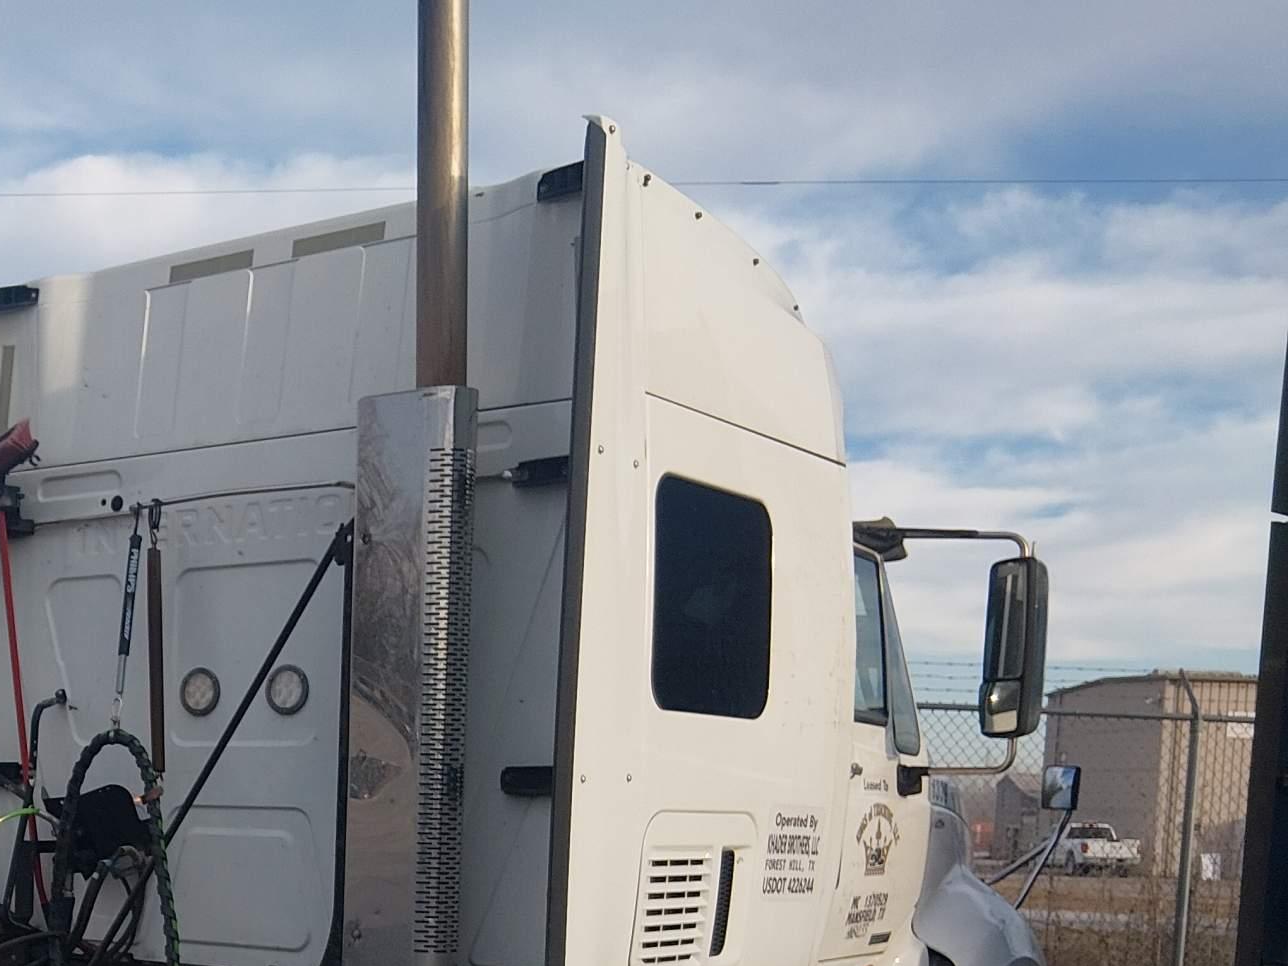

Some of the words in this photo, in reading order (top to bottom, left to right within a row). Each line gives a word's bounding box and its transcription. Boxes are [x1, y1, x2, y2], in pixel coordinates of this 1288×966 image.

[775, 812, 809, 830] Operated
[809, 814, 819, 832] By
[765, 858, 787, 871] FOREST
[808, 859, 815, 872] TX
[762, 876, 787, 895] USDOT
